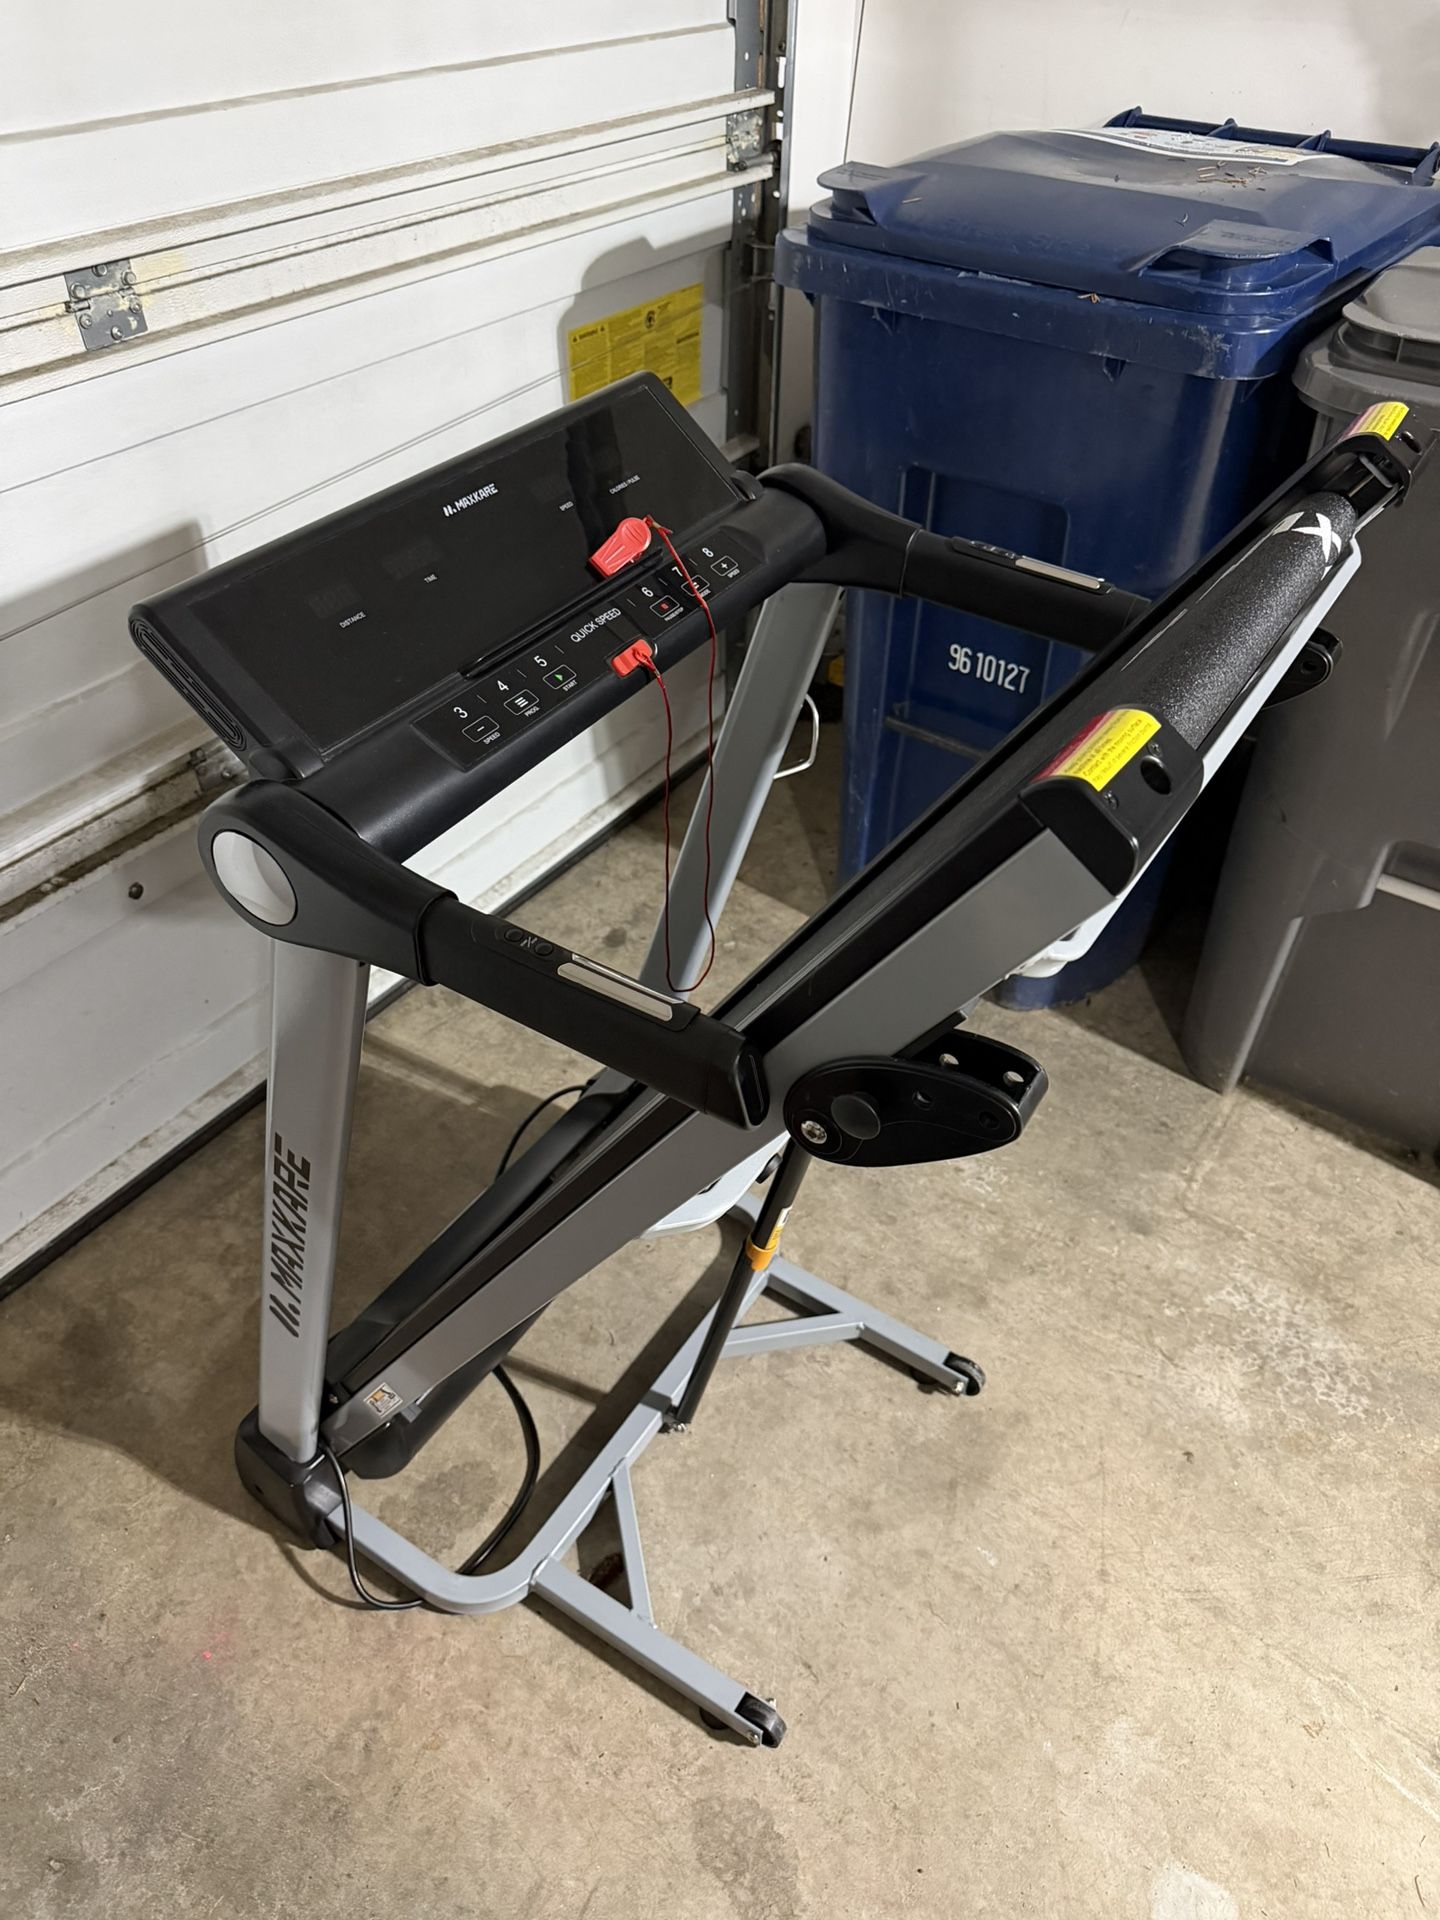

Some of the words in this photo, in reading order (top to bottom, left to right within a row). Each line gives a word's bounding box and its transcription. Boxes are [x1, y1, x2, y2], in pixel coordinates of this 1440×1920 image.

[454, 483, 498, 511] MAXKARE
[339, 611, 366, 629] DISTANCE
[453, 706, 468, 719] 3
[497, 680, 509, 691] 4
[533, 655, 548, 667] 5
[570, 621, 599, 643] QUICK
[594, 607, 622, 626] SPEED
[641, 586, 654, 597] 6
[671, 566, 683, 577] 7
[702, 547, 714, 558] 8
[562, 679, 578, 692] START
[483, 731, 501, 745] SPEED
[270, 1132, 311, 1304] MAXKARE
